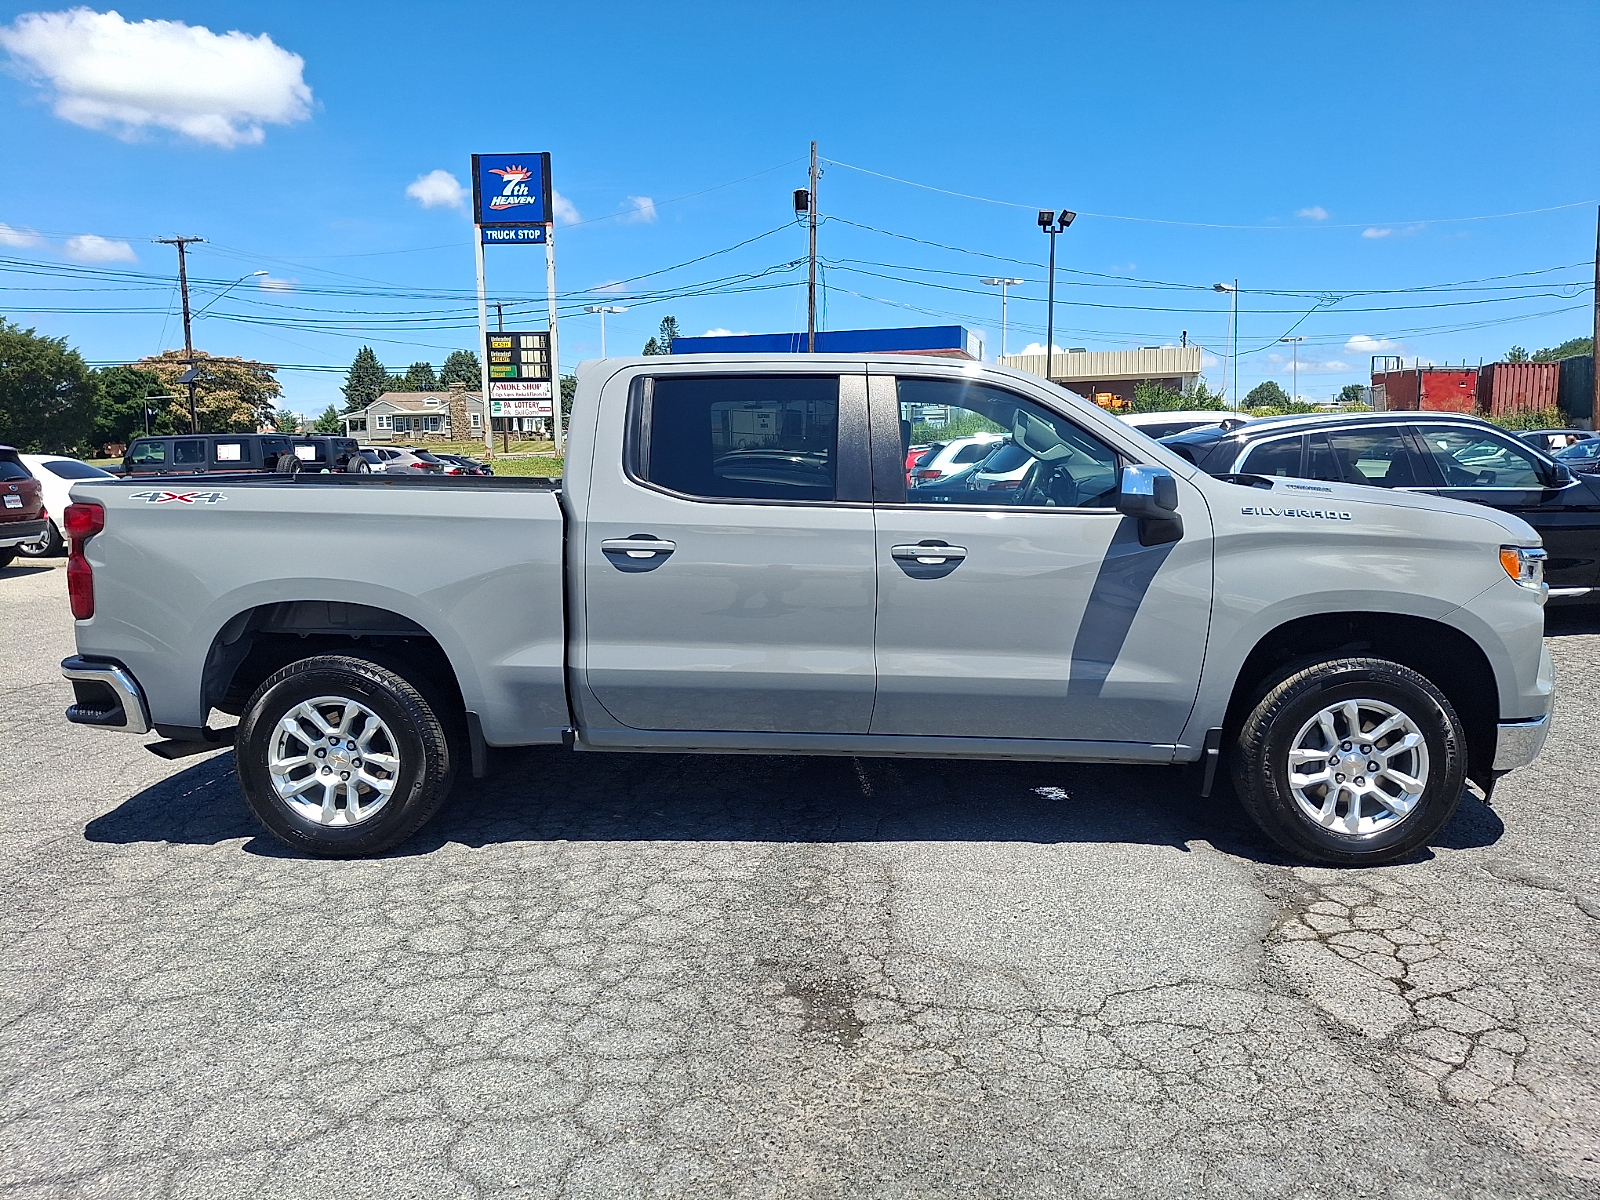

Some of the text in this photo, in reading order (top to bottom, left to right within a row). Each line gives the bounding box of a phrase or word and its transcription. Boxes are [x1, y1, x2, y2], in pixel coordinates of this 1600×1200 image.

[502, 174, 529, 195] 7th
[491, 196, 536, 206] HEAVEN
[485, 229, 541, 240] TRUCK STOP
[496, 383, 542, 391] SMOKE SHOP
[503, 401, 540, 409] PA LOTTERY
[1241, 506, 1353, 521] SILVERADO
